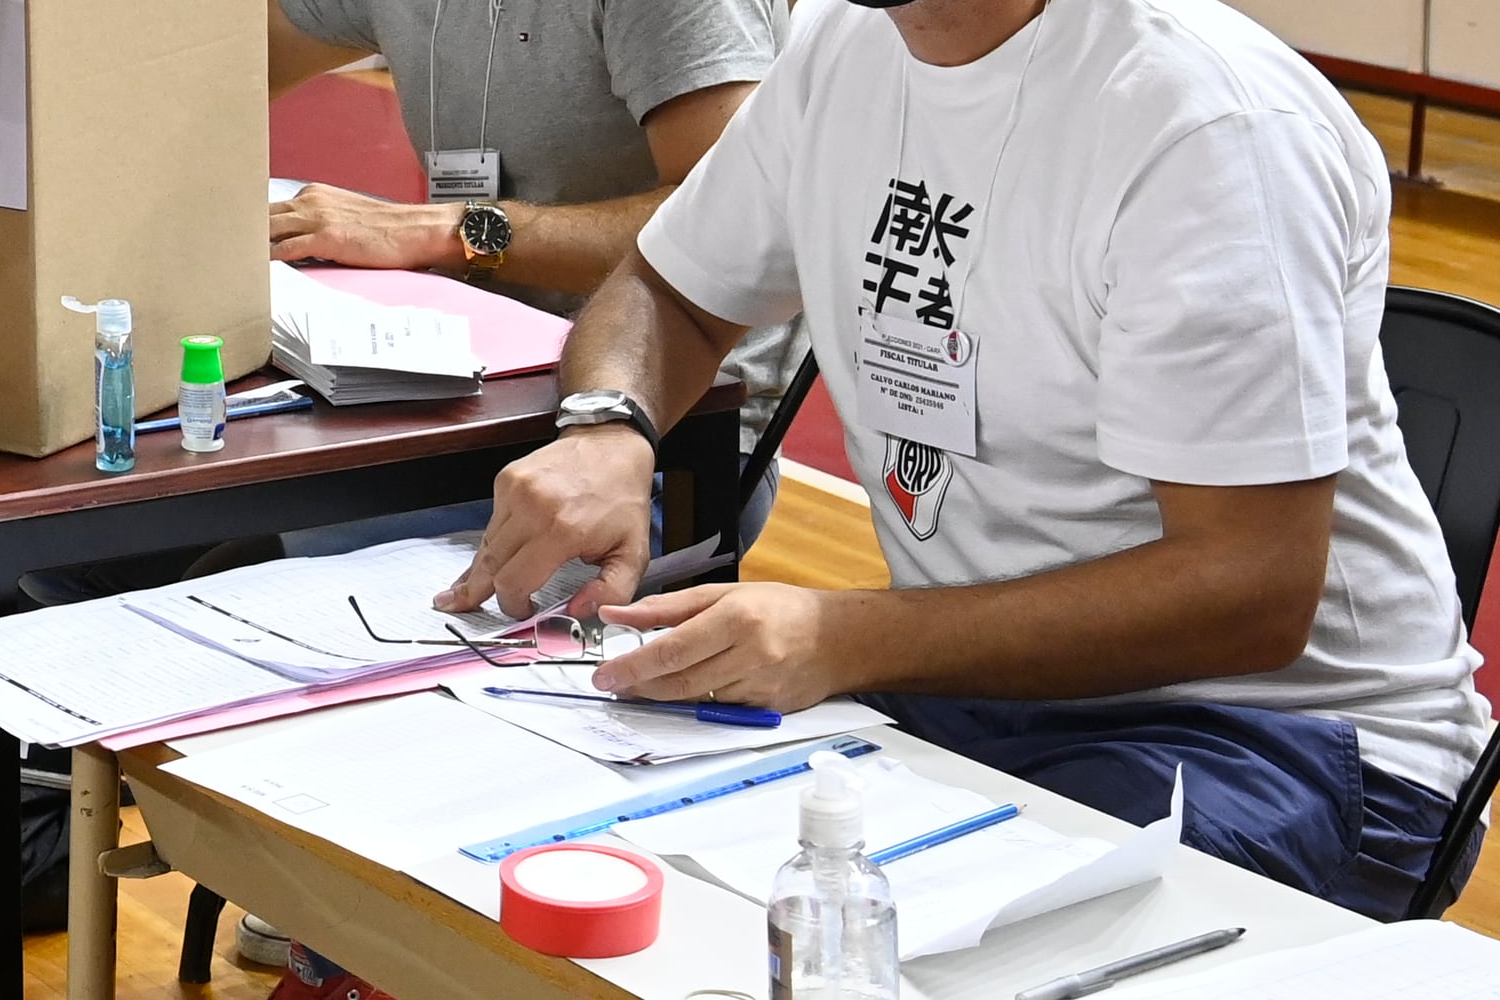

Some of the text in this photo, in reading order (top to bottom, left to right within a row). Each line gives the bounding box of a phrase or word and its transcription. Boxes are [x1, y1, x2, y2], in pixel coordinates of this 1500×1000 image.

[880, 349, 939, 372] FISCAL TITULAR
[870, 373, 956, 402] CALVO CARLOS MARIANO
[889, 388, 898, 397] DE
